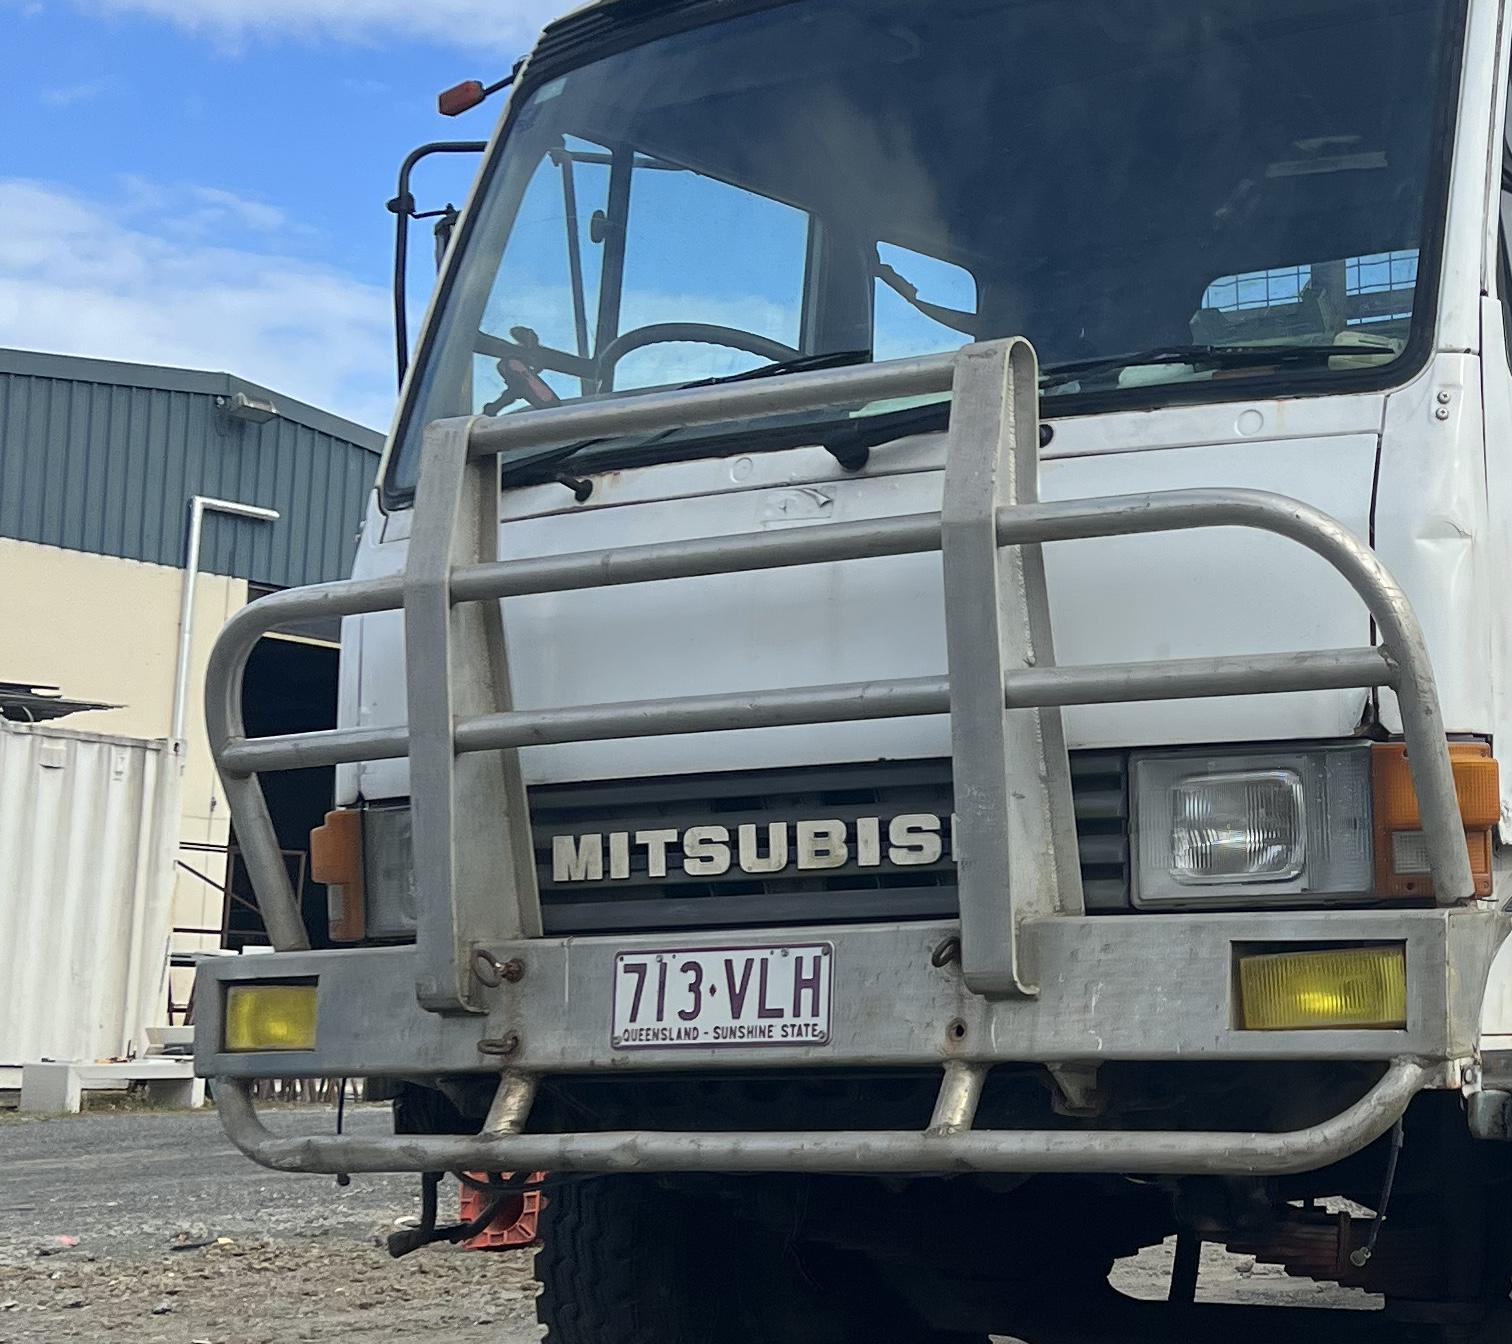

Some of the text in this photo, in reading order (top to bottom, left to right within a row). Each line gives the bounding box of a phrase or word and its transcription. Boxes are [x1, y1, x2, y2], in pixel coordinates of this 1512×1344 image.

[552, 812, 957, 882] MITSUBIS
[623, 1026, 699, 1042] QUEENSLAND
[713, 1024, 774, 1040] SUNSHINE
[781, 1023, 819, 1038] STATE
